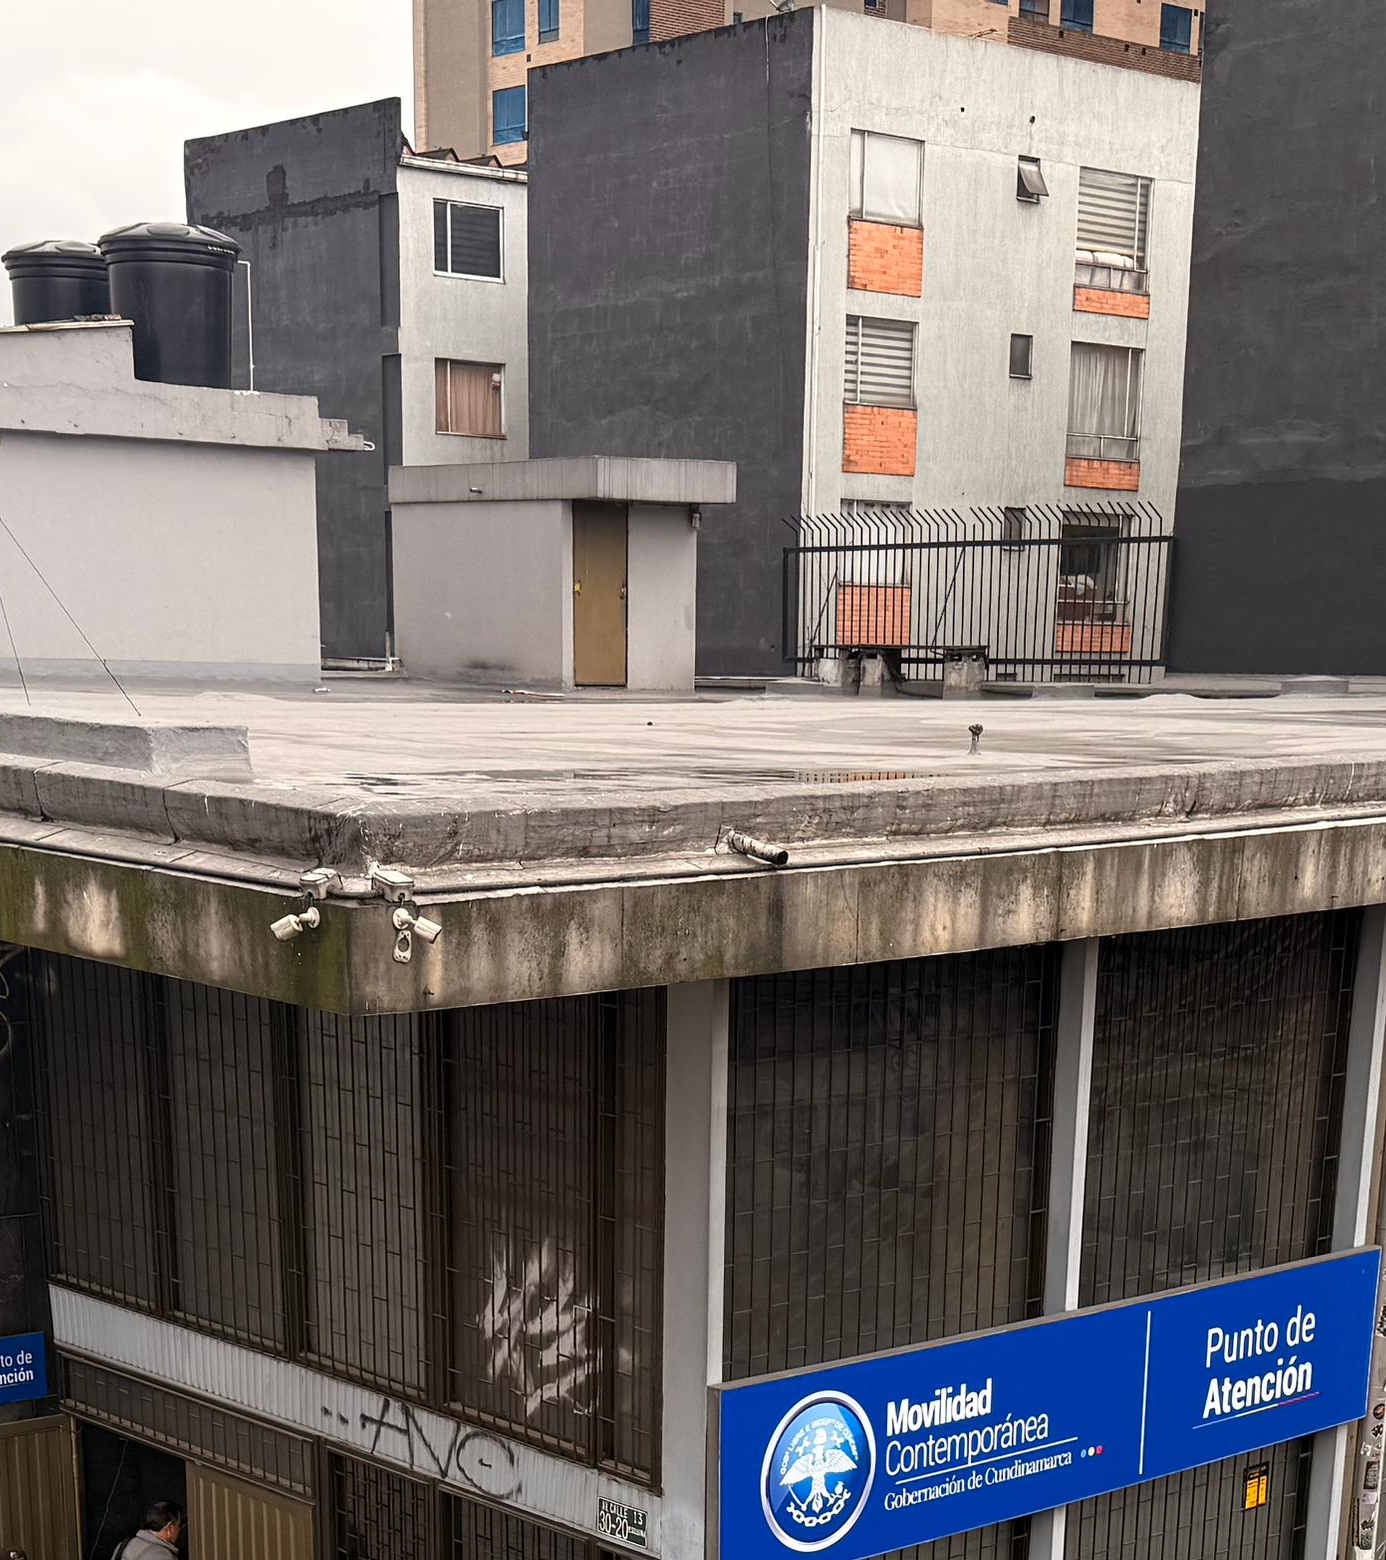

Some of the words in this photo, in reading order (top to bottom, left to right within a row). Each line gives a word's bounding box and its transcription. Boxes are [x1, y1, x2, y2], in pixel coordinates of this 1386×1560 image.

[16, 1350, 33, 1364] de
[1205, 1319, 1279, 1368] Punto
[1286, 1304, 1316, 1347] de
[886, 1378, 992, 1437] Movilidad
[1202, 1355, 1313, 1419] Atención
[885, 1413, 1049, 1477] Contemporánea
[884, 1475, 965, 1511] Gobernación
[967, 1471, 983, 1490] de
[985, 1450, 1072, 1486] Cundinamarca
[599, 1510, 628, 1540] 30-20
[633, 1511, 643, 1525] 13
